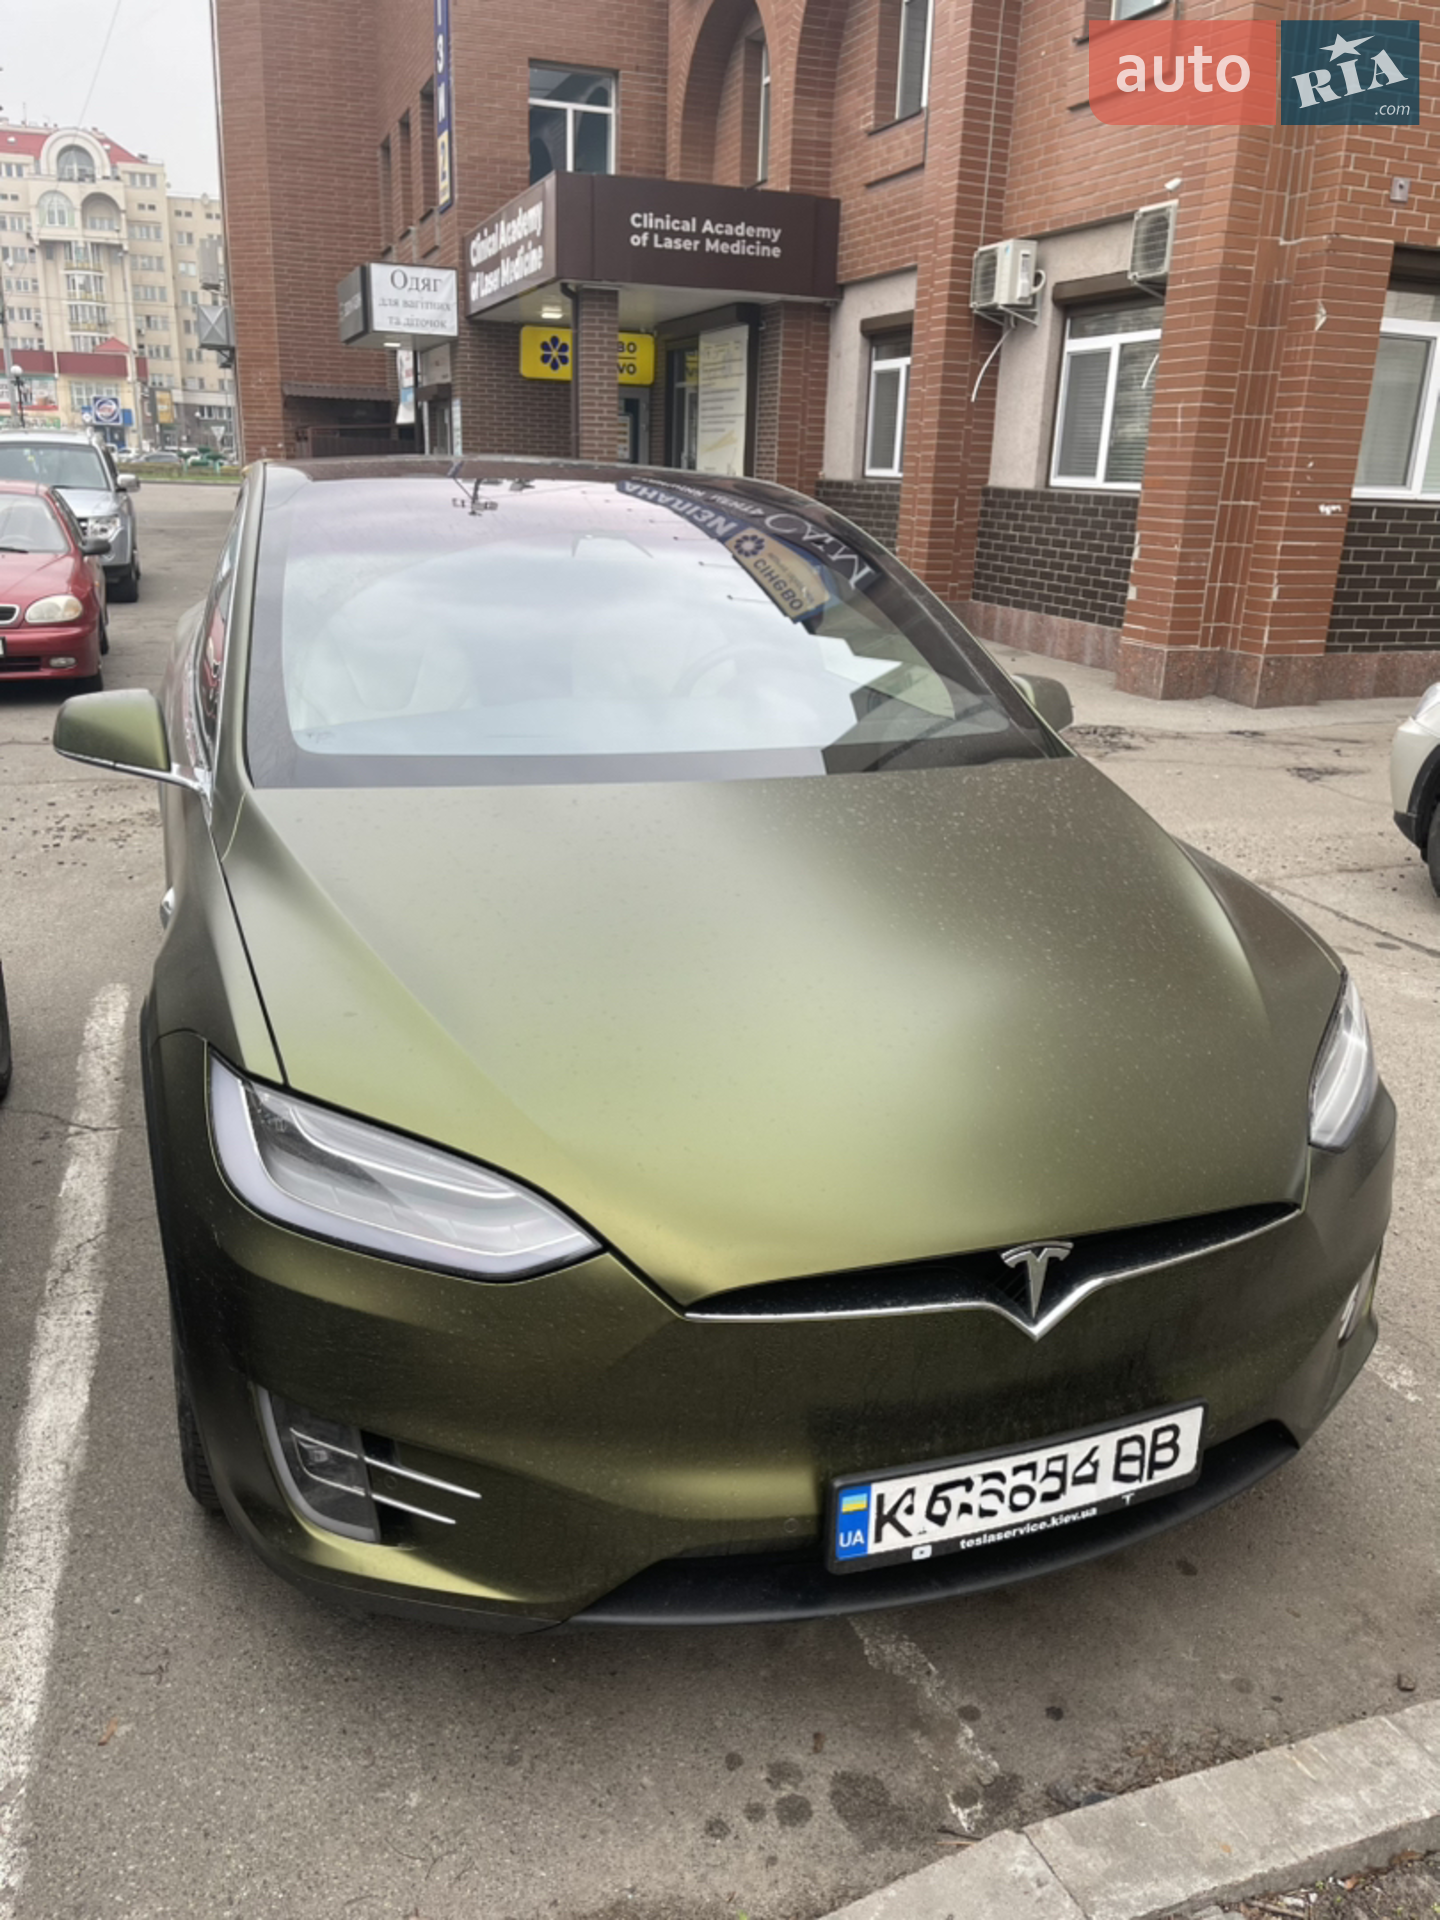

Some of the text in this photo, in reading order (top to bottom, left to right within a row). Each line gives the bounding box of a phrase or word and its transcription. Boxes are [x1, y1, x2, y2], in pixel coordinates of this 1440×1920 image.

[470, 200, 543, 267] Clinical Academy
[630, 212, 782, 242] Clinical Academy
[630, 231, 782, 259] of Laser Medicine
[501, 240, 543, 288] Medicine
[390, 269, 443, 293] Одяг
[839, 1530, 865, 1547] UA
[959, 1507, 1098, 1549] teslaservice.kiev.ua
